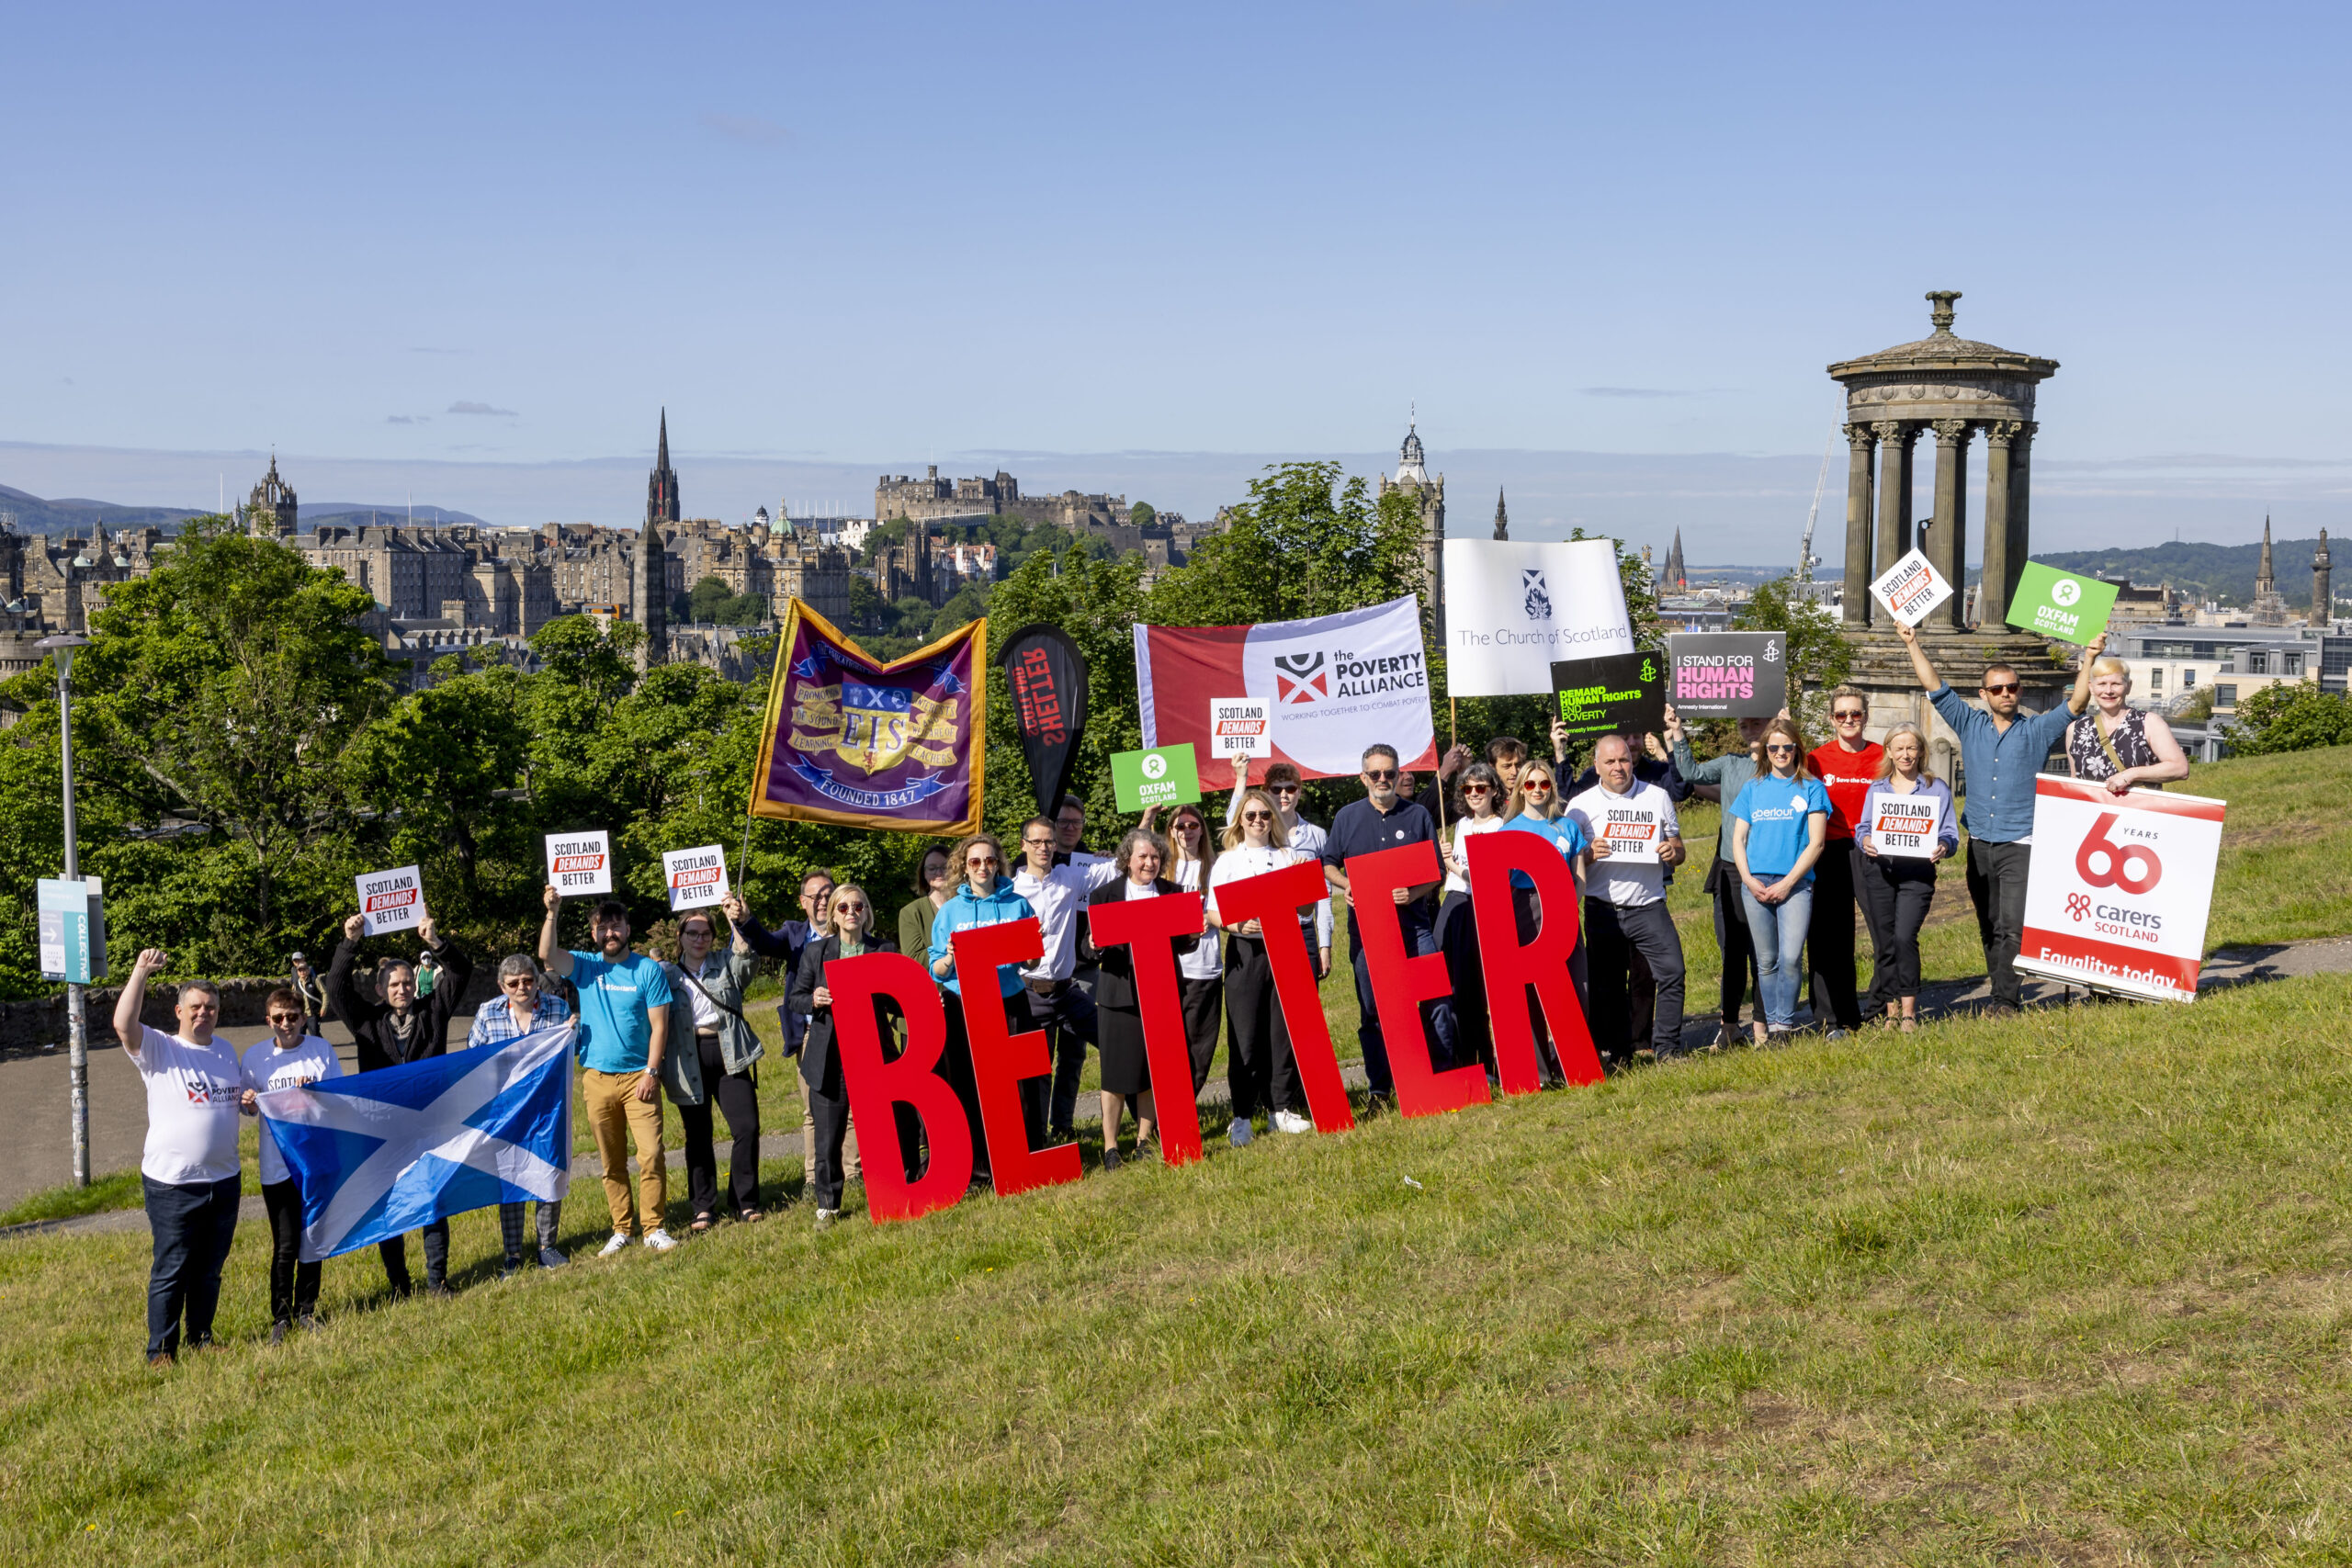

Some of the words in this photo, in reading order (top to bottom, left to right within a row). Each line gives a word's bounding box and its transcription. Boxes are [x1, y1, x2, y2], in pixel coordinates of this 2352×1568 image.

[1883, 560, 1921, 596] SCOTLAND
[1893, 570, 1929, 606] DEMANDS
[1905, 588, 1935, 615] BETTER
[2038, 605, 2079, 626] OXFAM
[2034, 618, 2075, 636] SCOTLAND
[1458, 630, 1490, 645] The
[1496, 628, 1544, 645] Church
[1548, 629, 1559, 644] of
[1563, 625, 1627, 644] Scotland
[1334, 650, 1353, 661] the
[1677, 656, 1680, 666] I
[1683, 656, 1724, 666] STAND
[1727, 656, 1753, 666] FOR
[1336, 652, 1420, 679] POVERTY
[1677, 667, 1754, 682] HUMAN
[1338, 671, 1423, 698] ALLIANCE
[1677, 682, 1753, 698] RIGHTS
[797, 688, 840, 700] PROMOTION
[1559, 686, 1606, 699] DEMAND
[1561, 695, 1600, 706] HUMAN
[1602, 690, 1641, 702] RIGHTS
[915, 698, 956, 716] INTERESTS
[1219, 707, 1262, 719] SCOTLAND
[1282, 711, 1317, 721] WORKING
[1321, 705, 1358, 716] TOGETHER
[1361, 704, 1370, 712] TO
[1372, 699, 1400, 710] COMBAT
[1402, 696, 1428, 706] POVERTY
[1562, 705, 1581, 715] END
[796, 711, 807, 720] OF
[808, 714, 839, 725] SOUND
[1563, 709, 1607, 722] POVERTY
[842, 712, 906, 753] EIS
[945, 728, 954, 737] OF
[1221, 722, 1261, 735] DEMANDS
[1587, 723, 1617, 731] International
[794, 736, 832, 748] LEARNING
[1225, 737, 1255, 749] BETTER
[911, 745, 952, 764] TEACHERS
[820, 781, 880, 807] FOUNDED
[884, 790, 916, 807] 1847
[1139, 781, 1176, 795] OXFAM
[1141, 793, 1177, 804] SCOTLAND
[1608, 809, 1653, 822] SCOTLAND
[1751, 808, 1793, 818] aberlour
[1882, 803, 1930, 817] SCOTLAND
[1609, 824, 1651, 838] DEMANDS
[1883, 818, 1928, 832] DEMANDS
[1885, 834, 1919, 847] BETTER
[2124, 828, 2159, 840] YEARS
[555, 841, 601, 855] SCOTLAND
[1611, 840, 1643, 852] BETTER
[2075, 812, 2163, 895] 60
[558, 856, 600, 871] DEMANDS
[673, 854, 717, 872] SCOTLAND
[562, 873, 594, 886] BETTER
[677, 869, 718, 886] DEMANDS
[366, 876, 413, 895] SCOTLAND
[683, 885, 714, 899] BETTER
[371, 891, 413, 911] DEMANDS
[377, 908, 409, 924] BETTER
[2097, 904, 2162, 930] carers
[2095, 921, 2158, 942] SCOTLAND
[77, 915, 88, 980] COLLECTIVE
[2041, 947, 2117, 976] Equality:
[2123, 965, 2177, 988] today
[824, 830, 1606, 1224] BETTER
